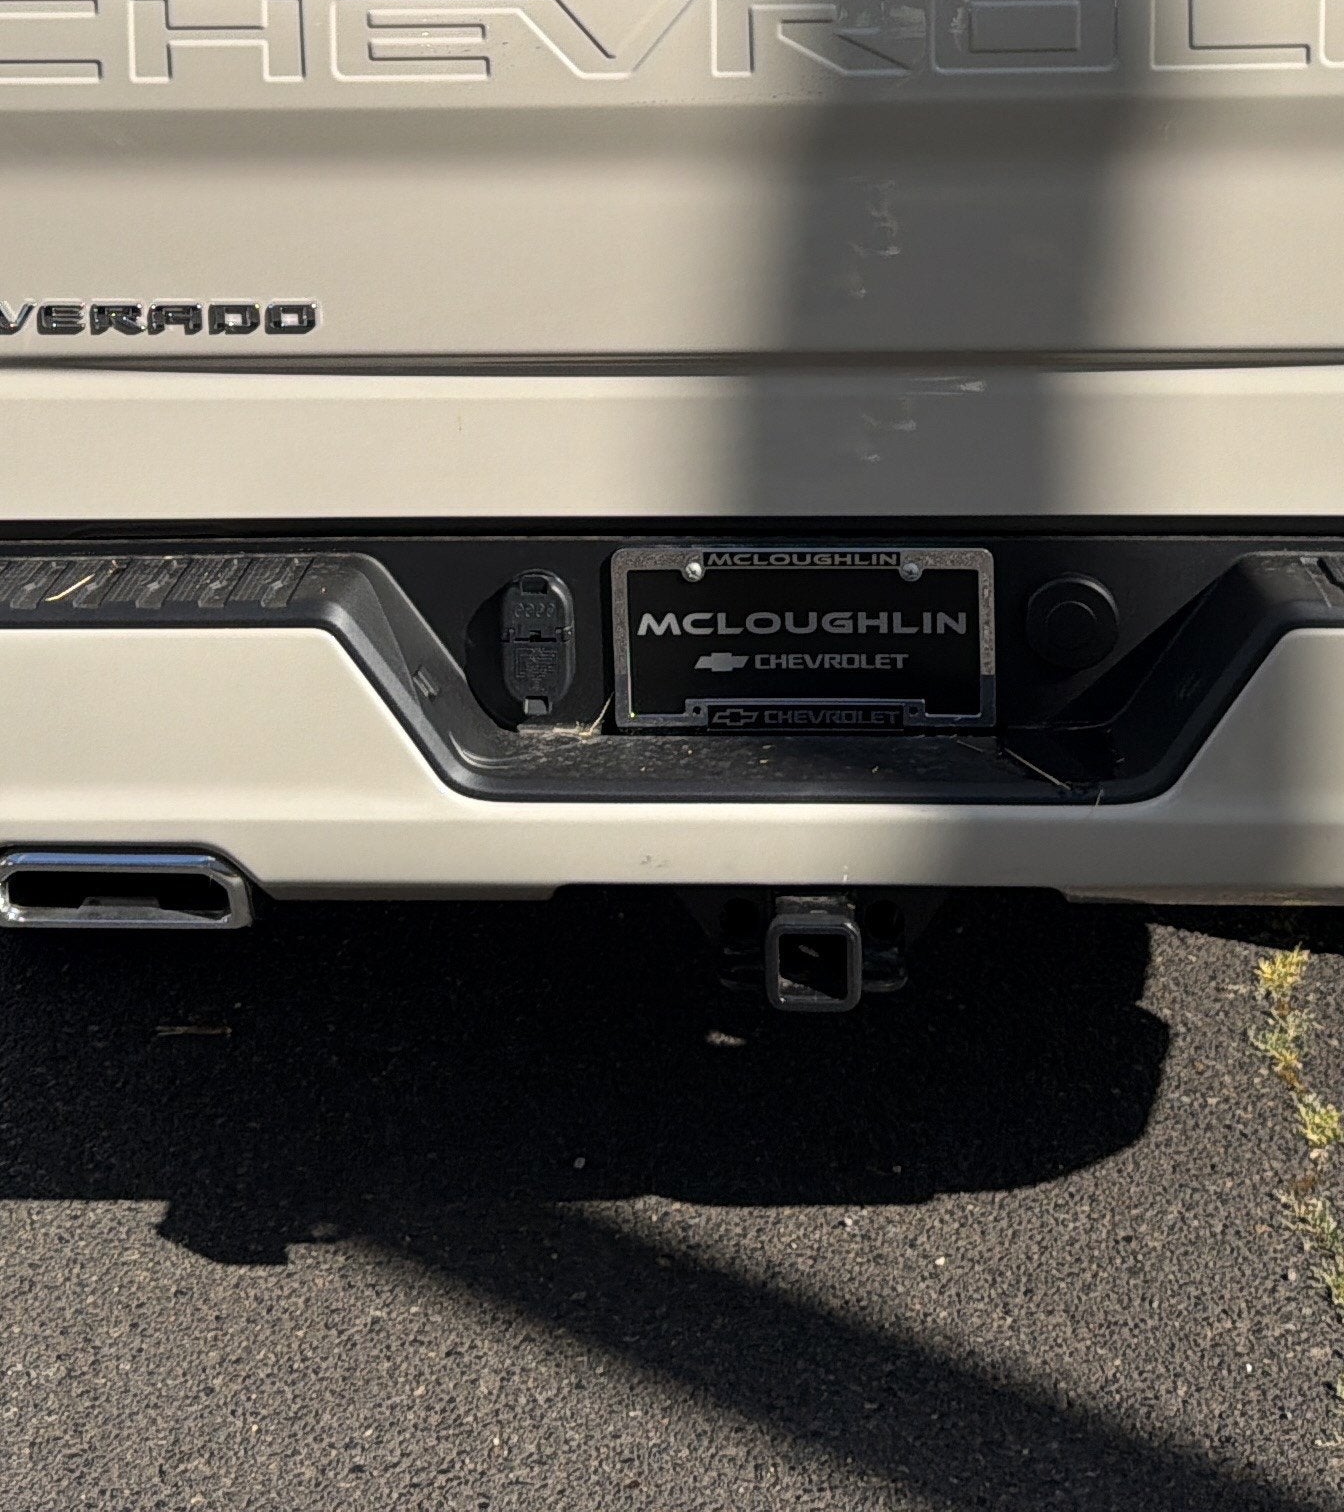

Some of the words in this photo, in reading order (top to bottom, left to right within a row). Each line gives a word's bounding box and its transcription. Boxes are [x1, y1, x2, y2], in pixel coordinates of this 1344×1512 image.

[707, 552, 898, 567] MCLOUGHLIN
[637, 611, 967, 636] MCLOUGHLIN
[755, 653, 909, 670] CHEVROLET
[763, 710, 900, 726] CHEVROLET
